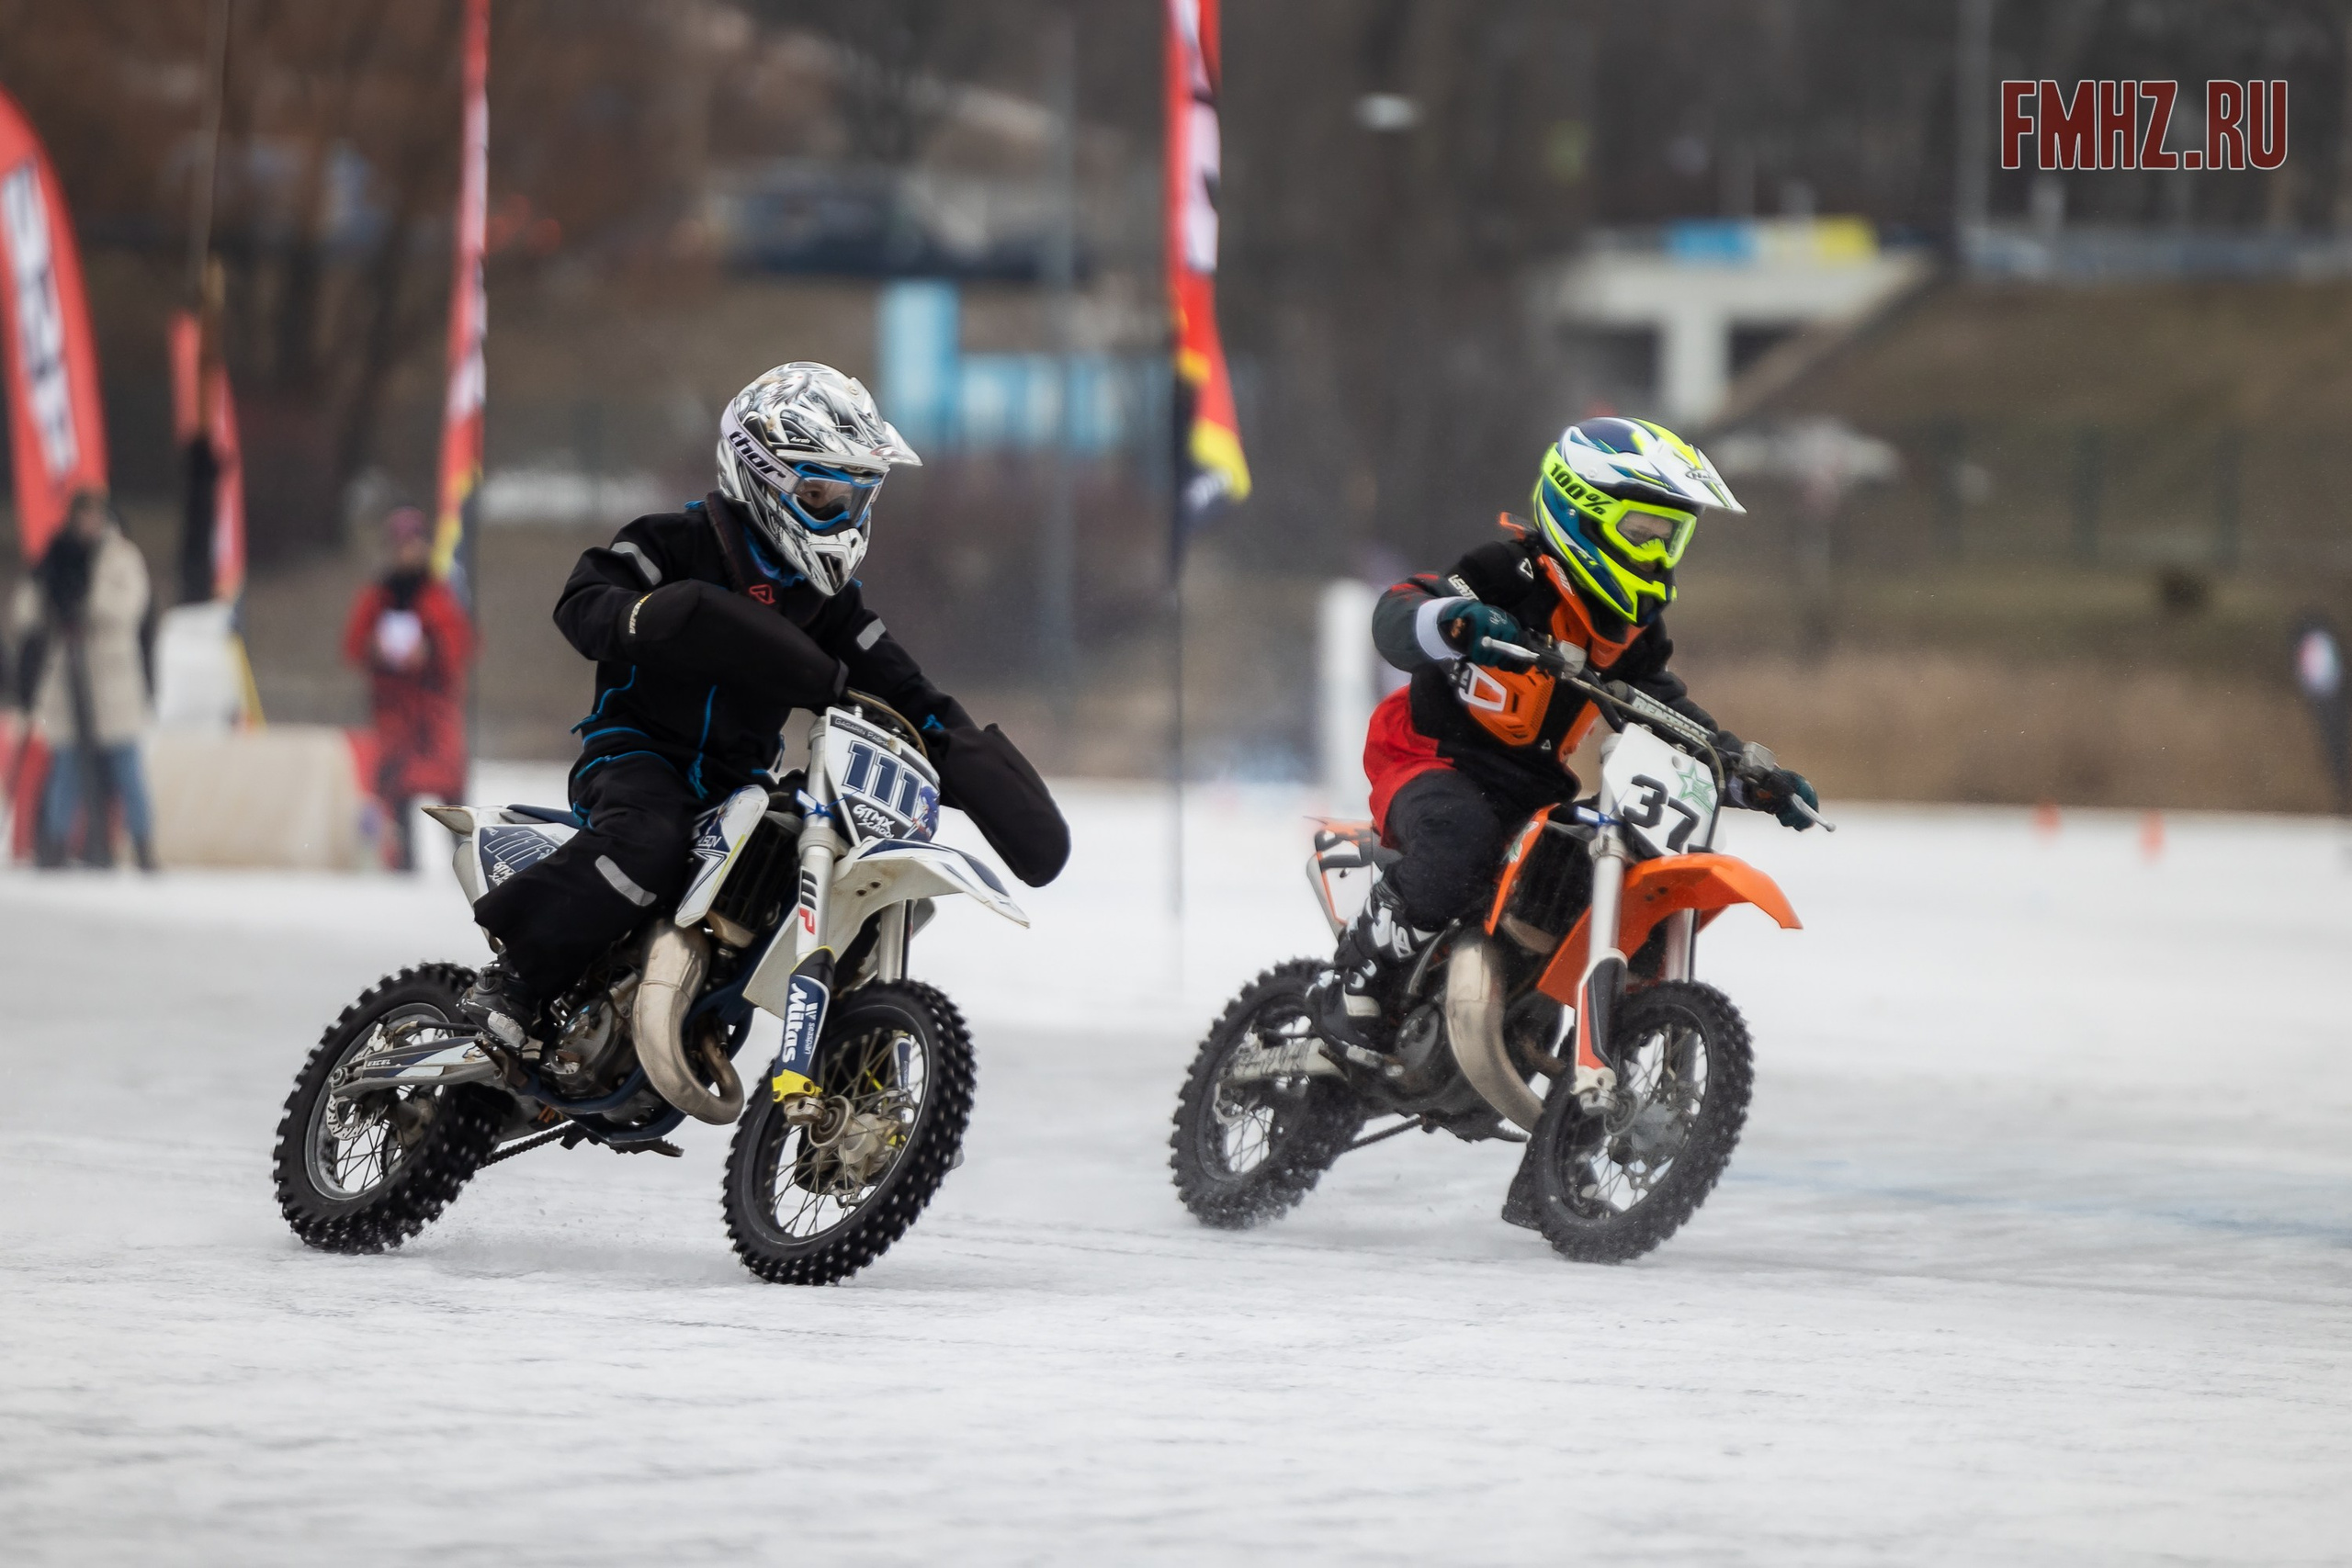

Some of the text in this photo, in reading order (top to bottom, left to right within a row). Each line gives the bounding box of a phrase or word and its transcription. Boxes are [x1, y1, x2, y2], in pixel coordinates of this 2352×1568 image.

[729, 431, 786, 479] thor
[1549, 462, 1613, 515] 100%
[842, 740, 922, 822] 111
[1623, 774, 1701, 853] 37
[782, 983, 808, 1063] Mitas
